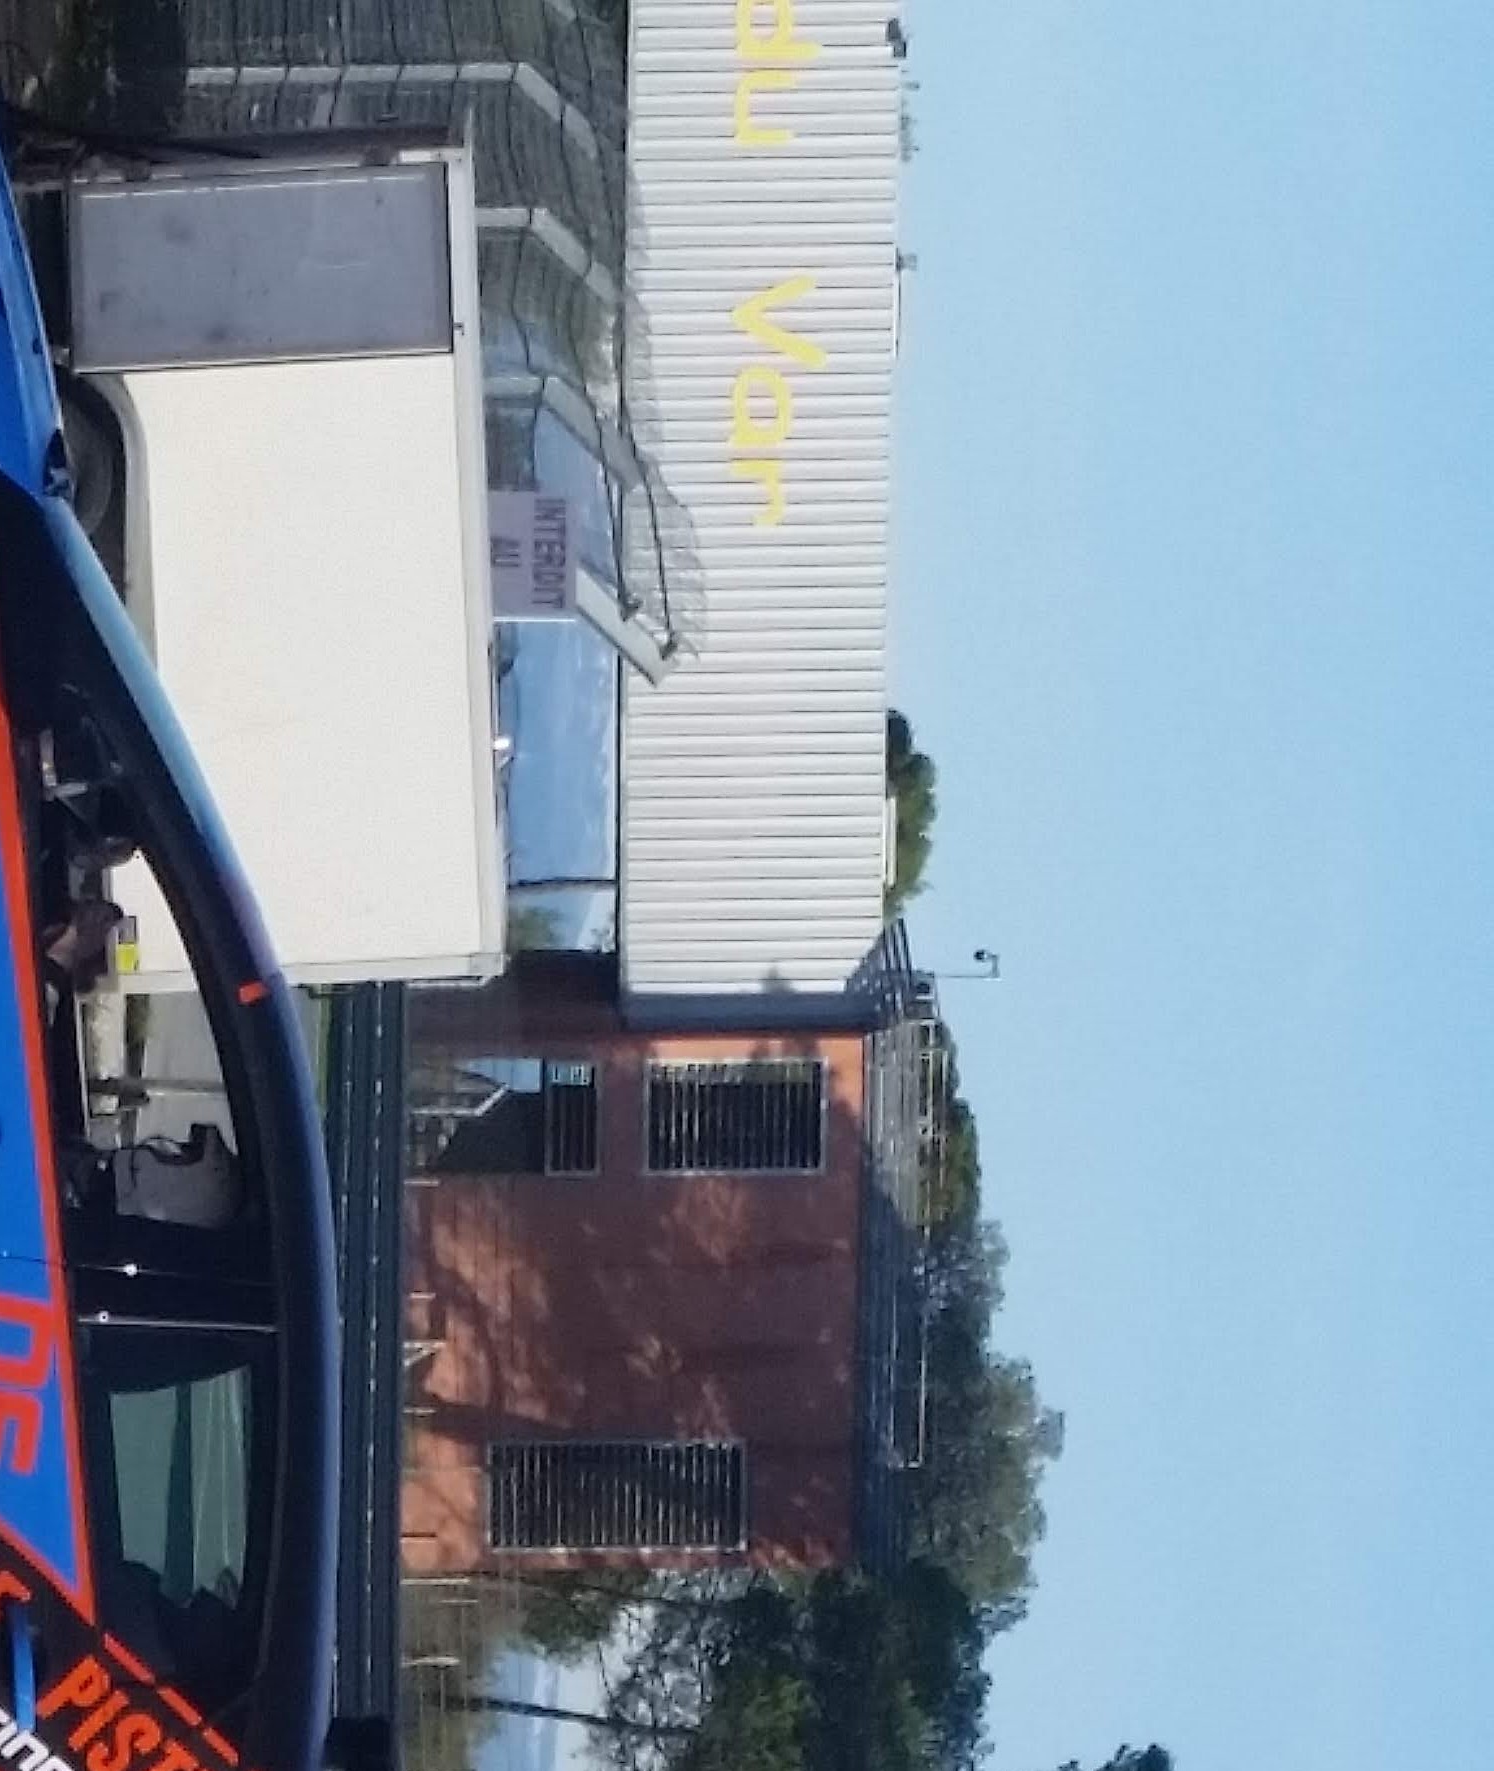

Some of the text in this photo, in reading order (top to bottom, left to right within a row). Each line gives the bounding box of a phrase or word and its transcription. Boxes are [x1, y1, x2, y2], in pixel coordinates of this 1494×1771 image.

[726, 0, 831, 527] du Var
[490, 536, 522, 568] AU
[532, 498, 568, 609] INTERDIT
